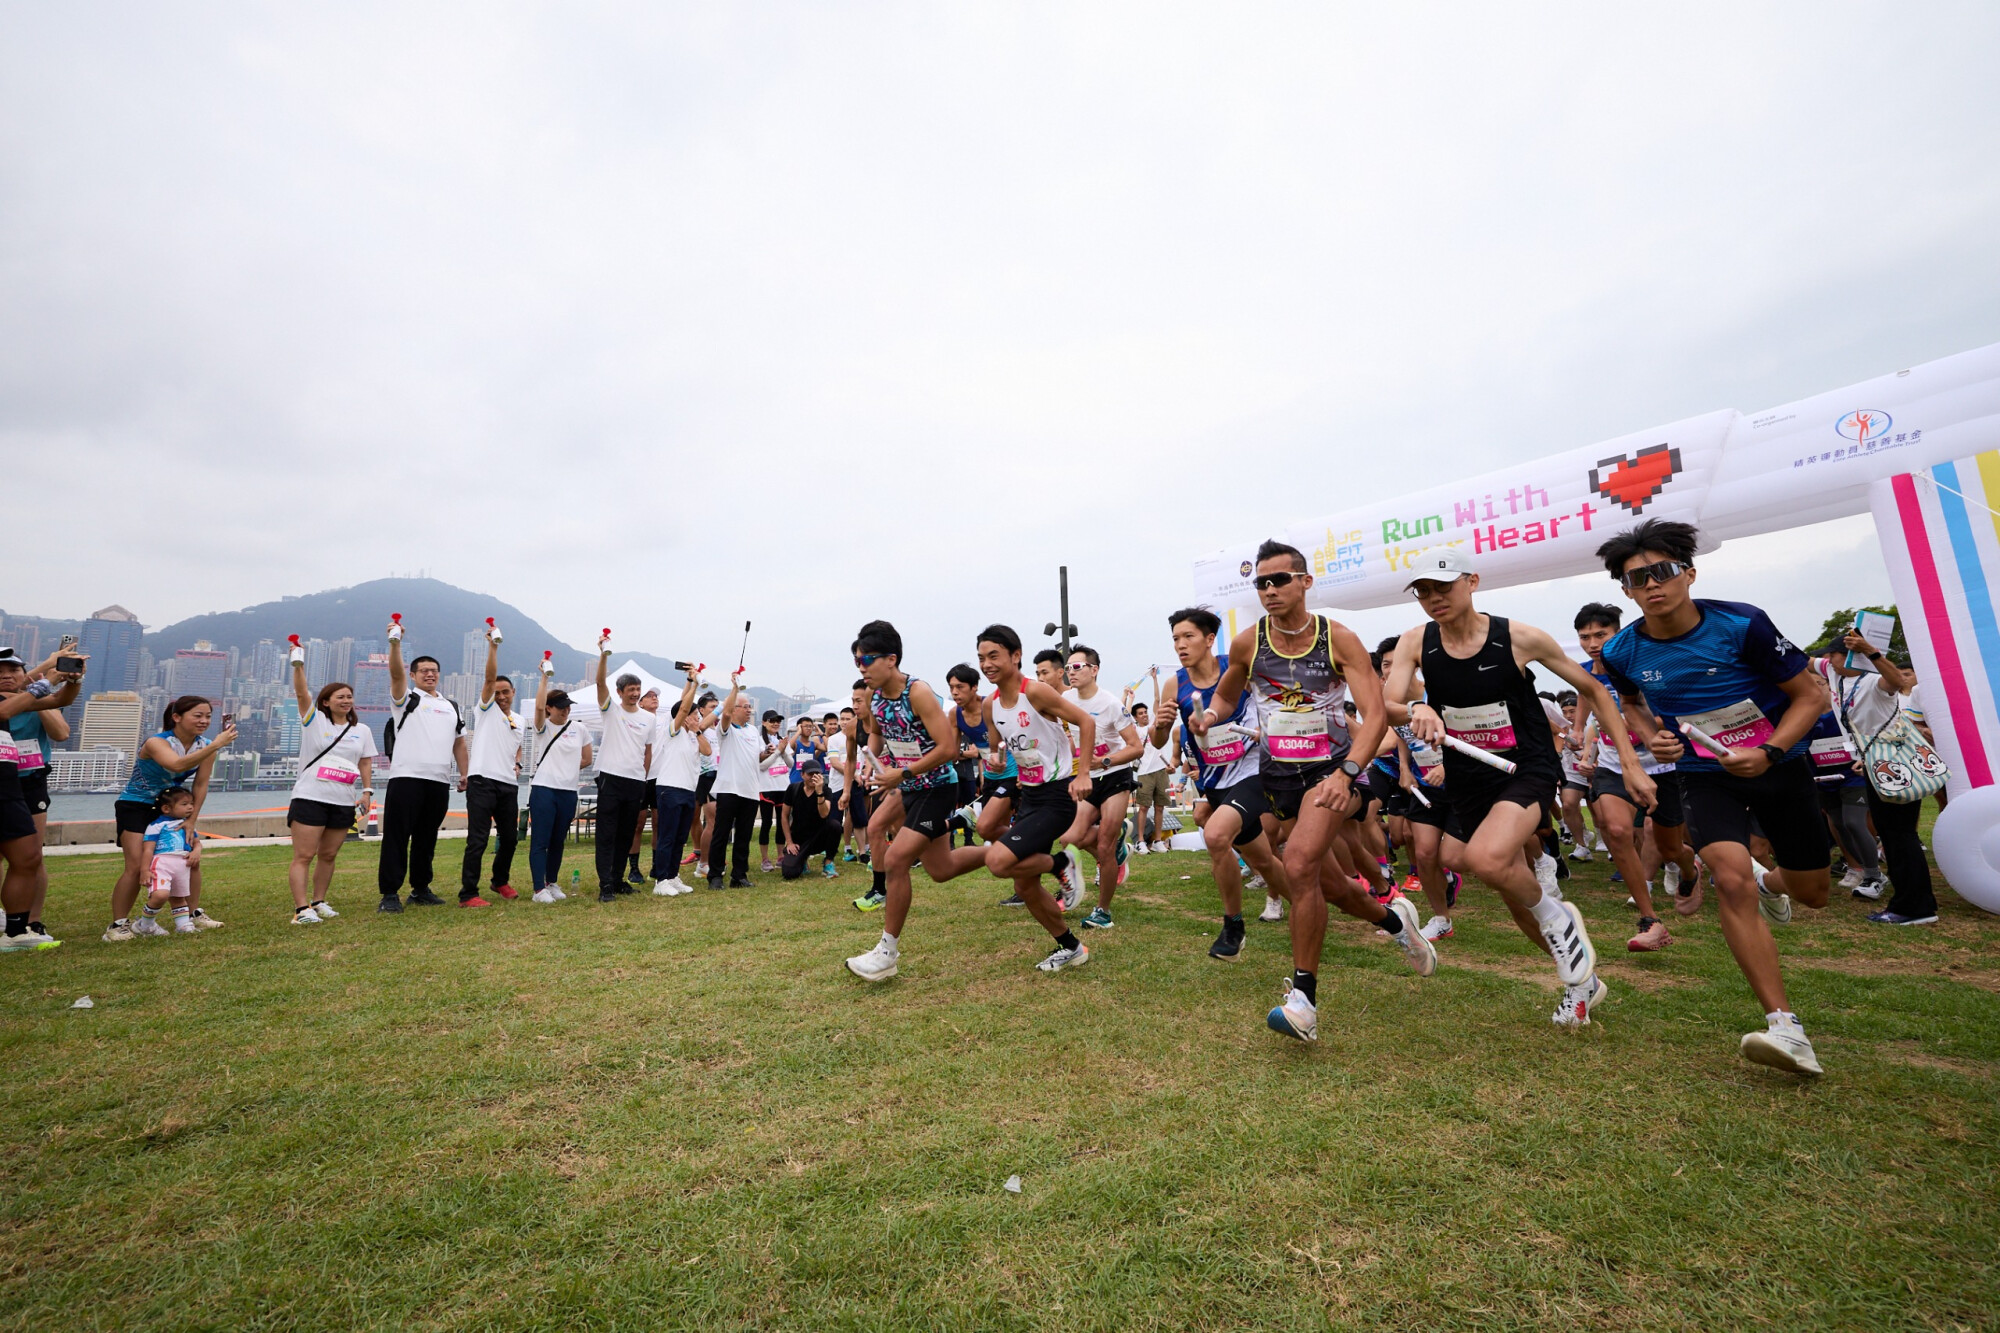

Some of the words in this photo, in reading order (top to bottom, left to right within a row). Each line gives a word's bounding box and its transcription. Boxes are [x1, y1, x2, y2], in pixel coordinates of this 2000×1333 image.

[1382, 514, 1444, 544] Run
[1454, 484, 1549, 528] With
[1473, 502, 1597, 554] Heart
[1336, 529, 1362, 545] JC
[1337, 543, 1363, 559] FIT
[1327, 556, 1364, 573] CITY
[1278, 739, 1316, 750] A3044a
